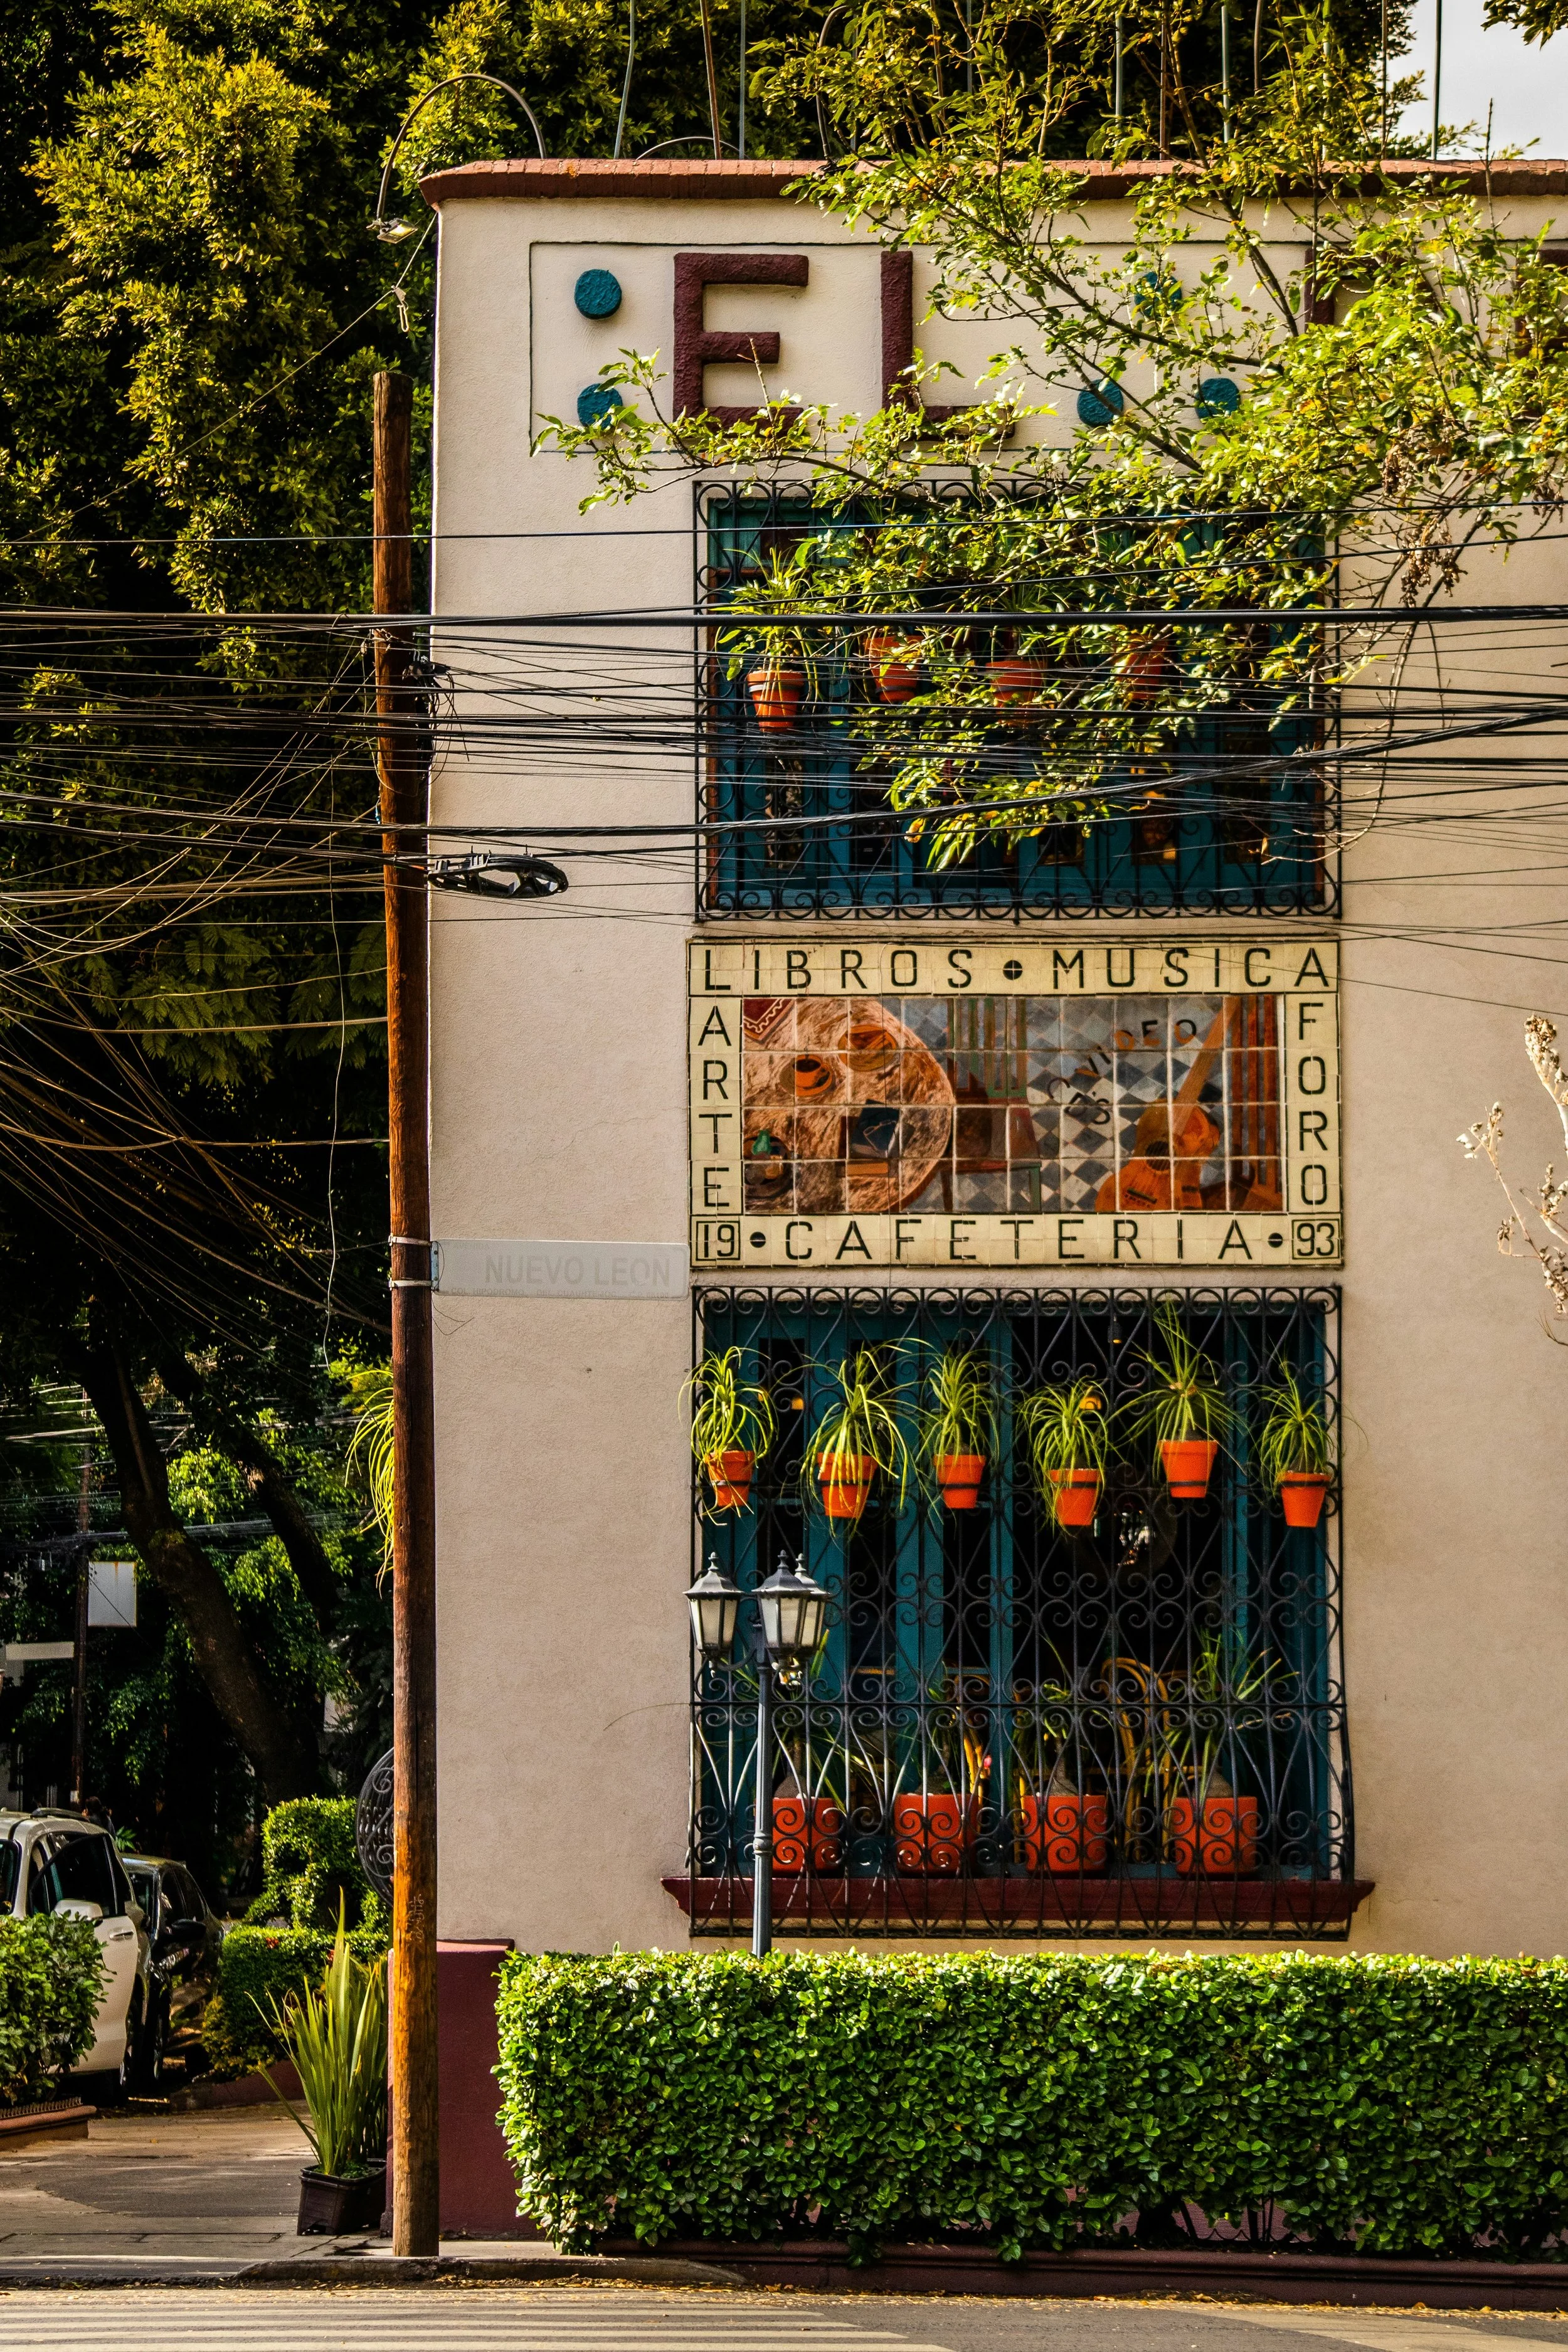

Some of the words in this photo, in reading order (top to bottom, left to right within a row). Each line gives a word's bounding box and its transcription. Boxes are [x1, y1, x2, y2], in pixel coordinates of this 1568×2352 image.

[673, 251, 1015, 441] EL
[703, 948, 973, 991] LIBROS
[1052, 946, 1330, 988] MUSICA
[1074, 1019, 1197, 1078] VIDEO
[696, 1005, 733, 1208] ARTE
[1296, 1002, 1328, 1205] FORO
[702, 1221, 736, 1258] 19
[784, 1218, 1253, 1260] CAFETERIA
[1296, 1221, 1335, 1256] 93
[485, 1254, 585, 1285] NUEVO
[593, 1256, 670, 1287] LEON
